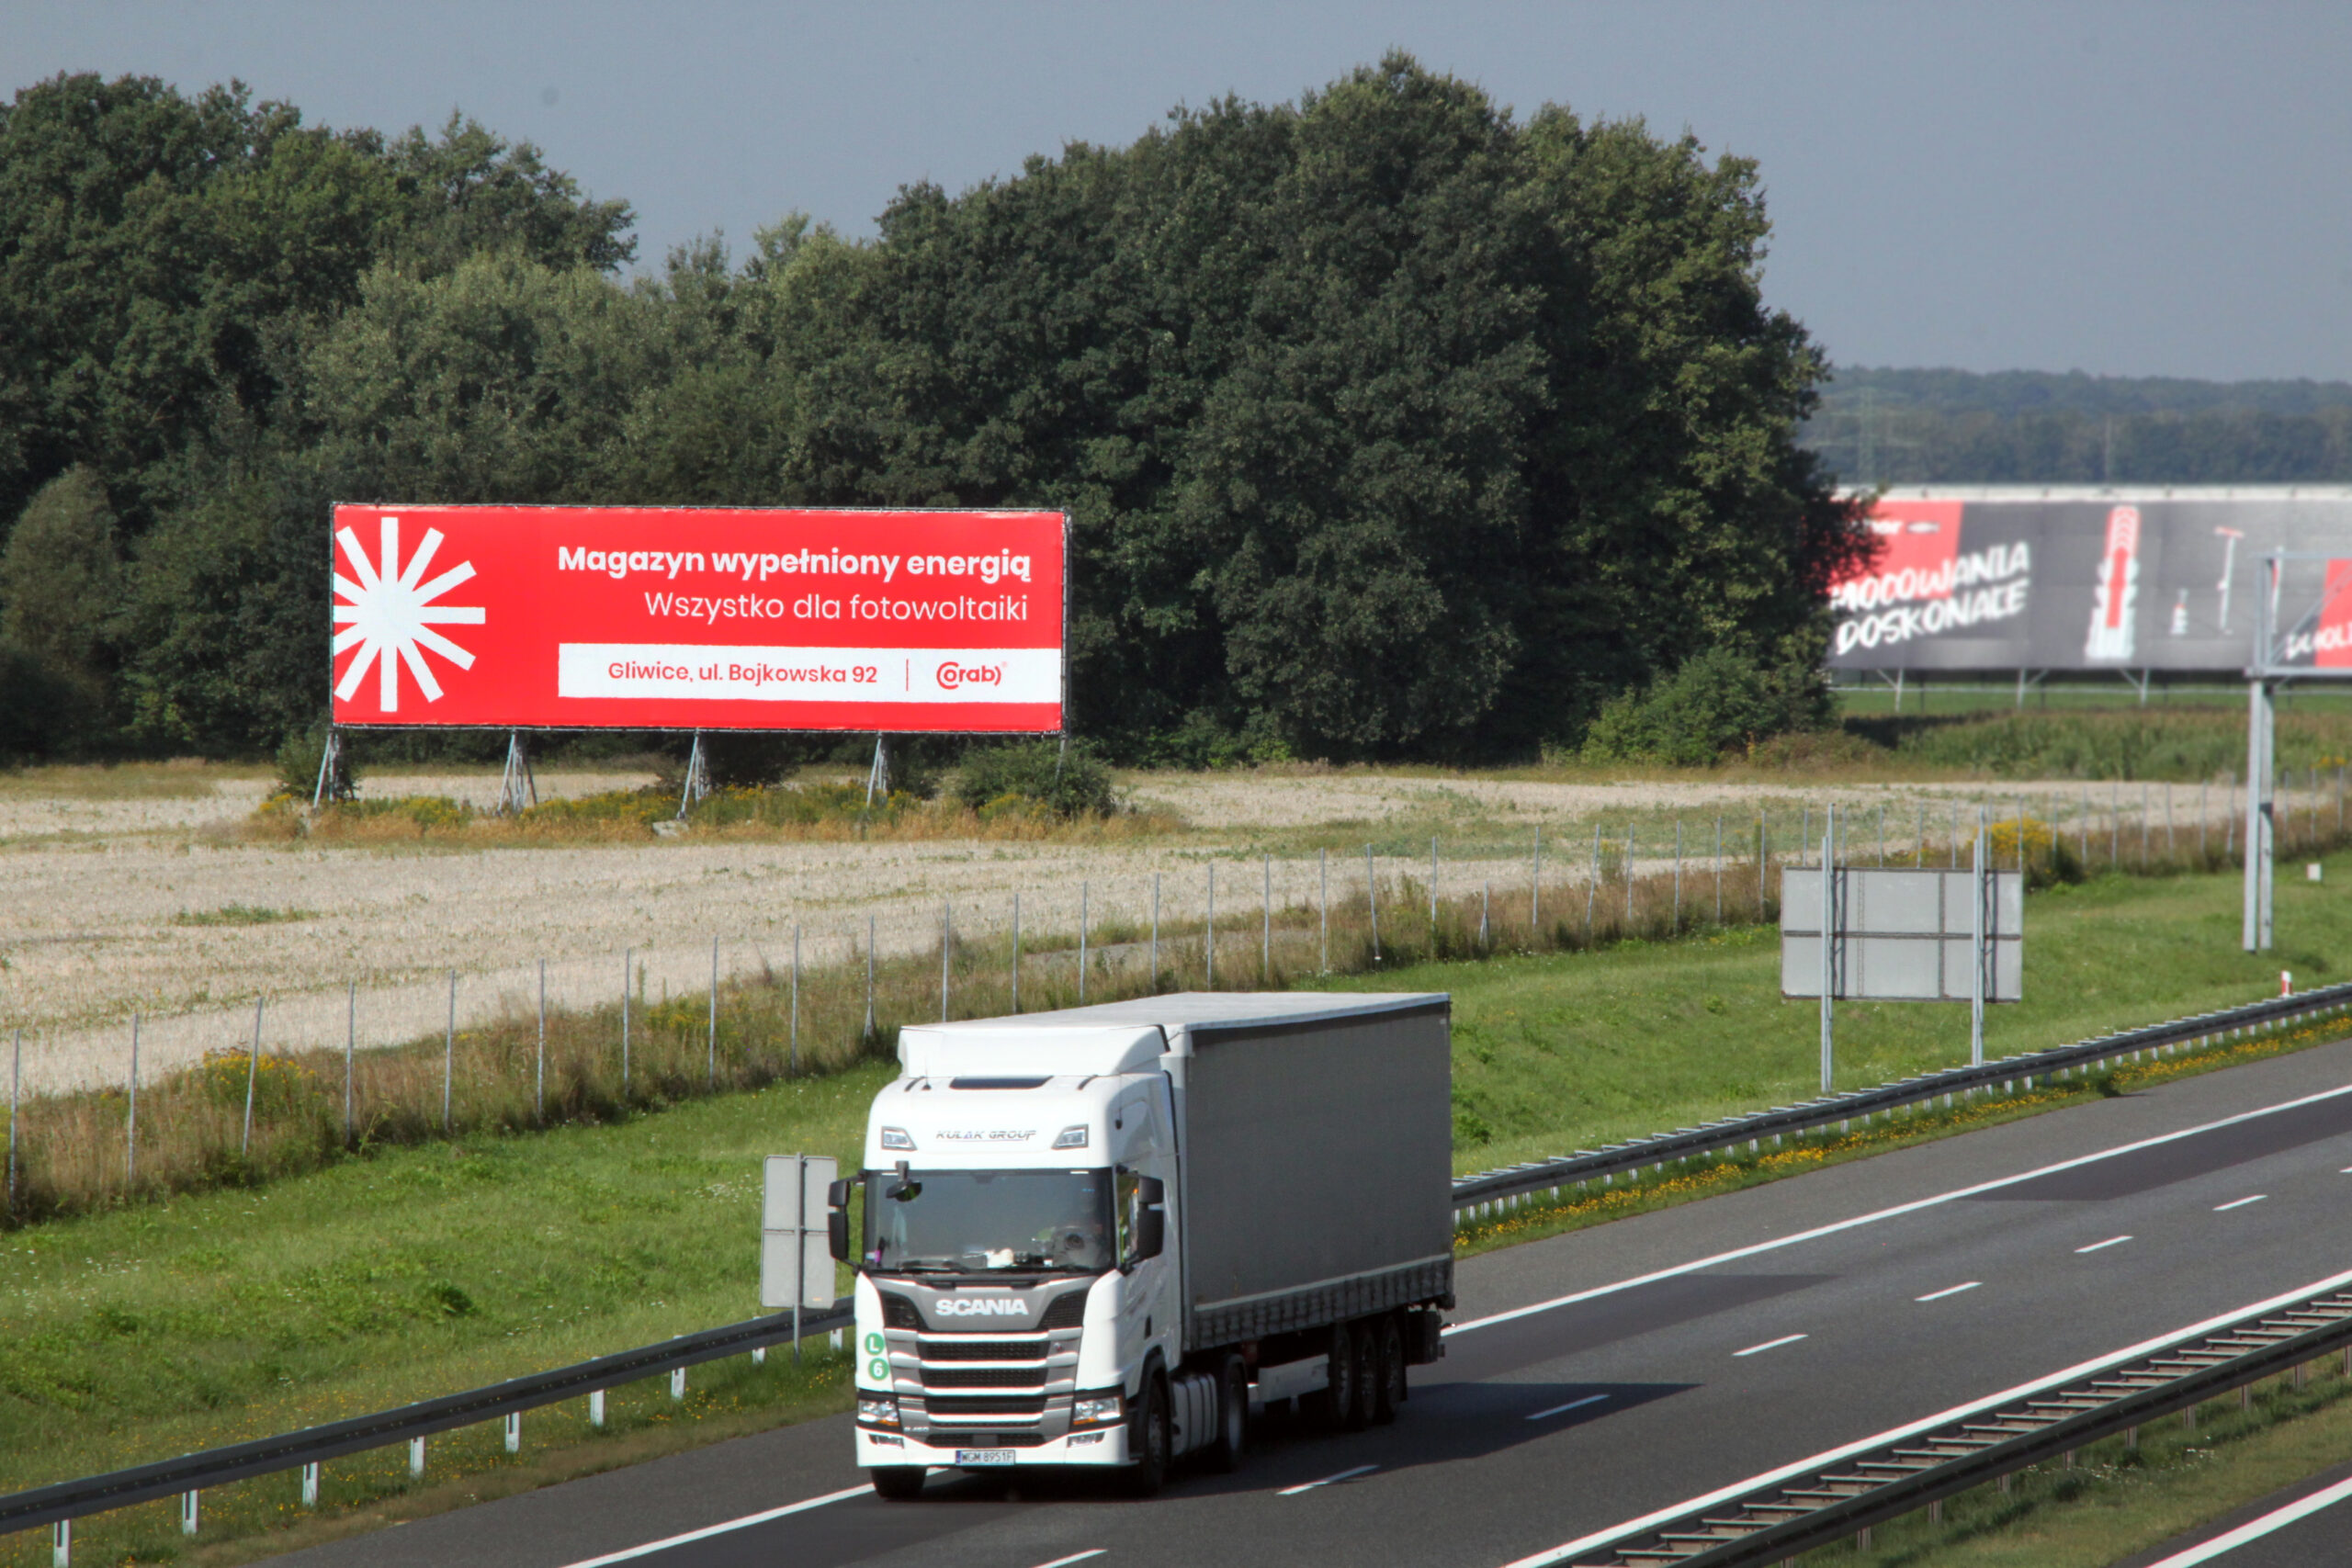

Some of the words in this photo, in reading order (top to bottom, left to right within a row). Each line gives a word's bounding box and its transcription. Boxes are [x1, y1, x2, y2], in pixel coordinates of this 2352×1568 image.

[558, 547, 705, 580] Magazyn
[711, 547, 900, 583] wypełniony
[907, 548, 1031, 584] energią
[645, 592, 785, 625] Wszystko
[794, 593, 841, 619] dla
[850, 594, 1028, 621] fotowoltaiki
[608, 661, 694, 682] Gliwice,
[699, 663, 723, 681] ul.
[729, 663, 846, 686] Bojkowska
[853, 666, 877, 683] 92
[935, 1130, 985, 1140] KULAK
[989, 1130, 1037, 1141] GROUP
[935, 1298, 1029, 1316] SCANIA
[869, 1336, 880, 1352] L
[873, 1361, 884, 1378] 6
